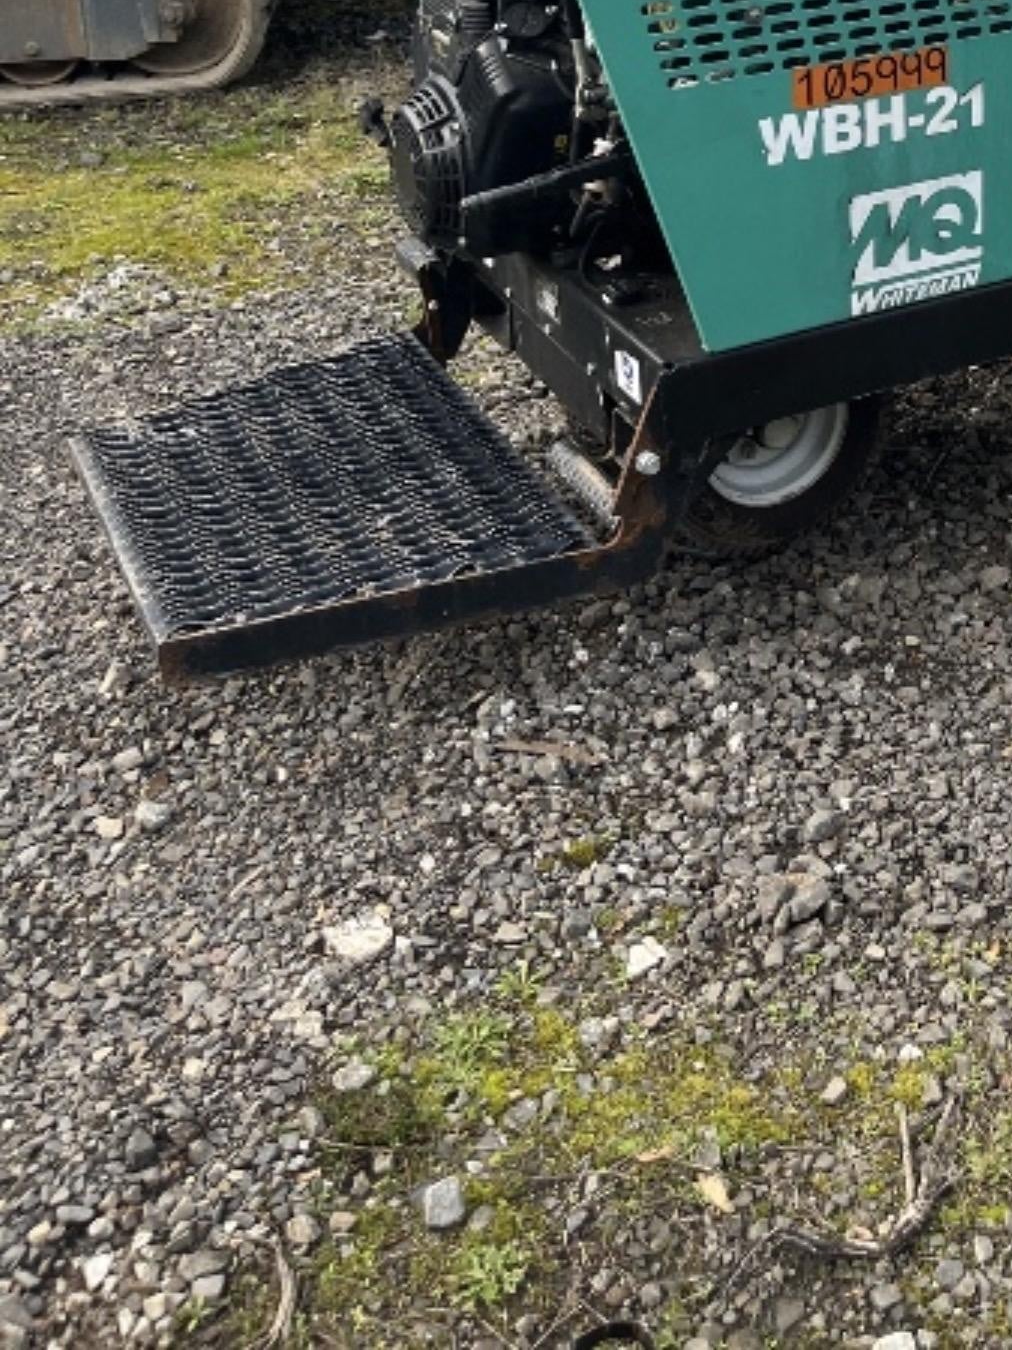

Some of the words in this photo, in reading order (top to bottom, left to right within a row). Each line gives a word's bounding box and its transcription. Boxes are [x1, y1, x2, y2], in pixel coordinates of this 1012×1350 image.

[797, 48, 947, 106] 105999
[759, 83, 985, 166] WBH-21
[850, 183, 983, 270] MQ
